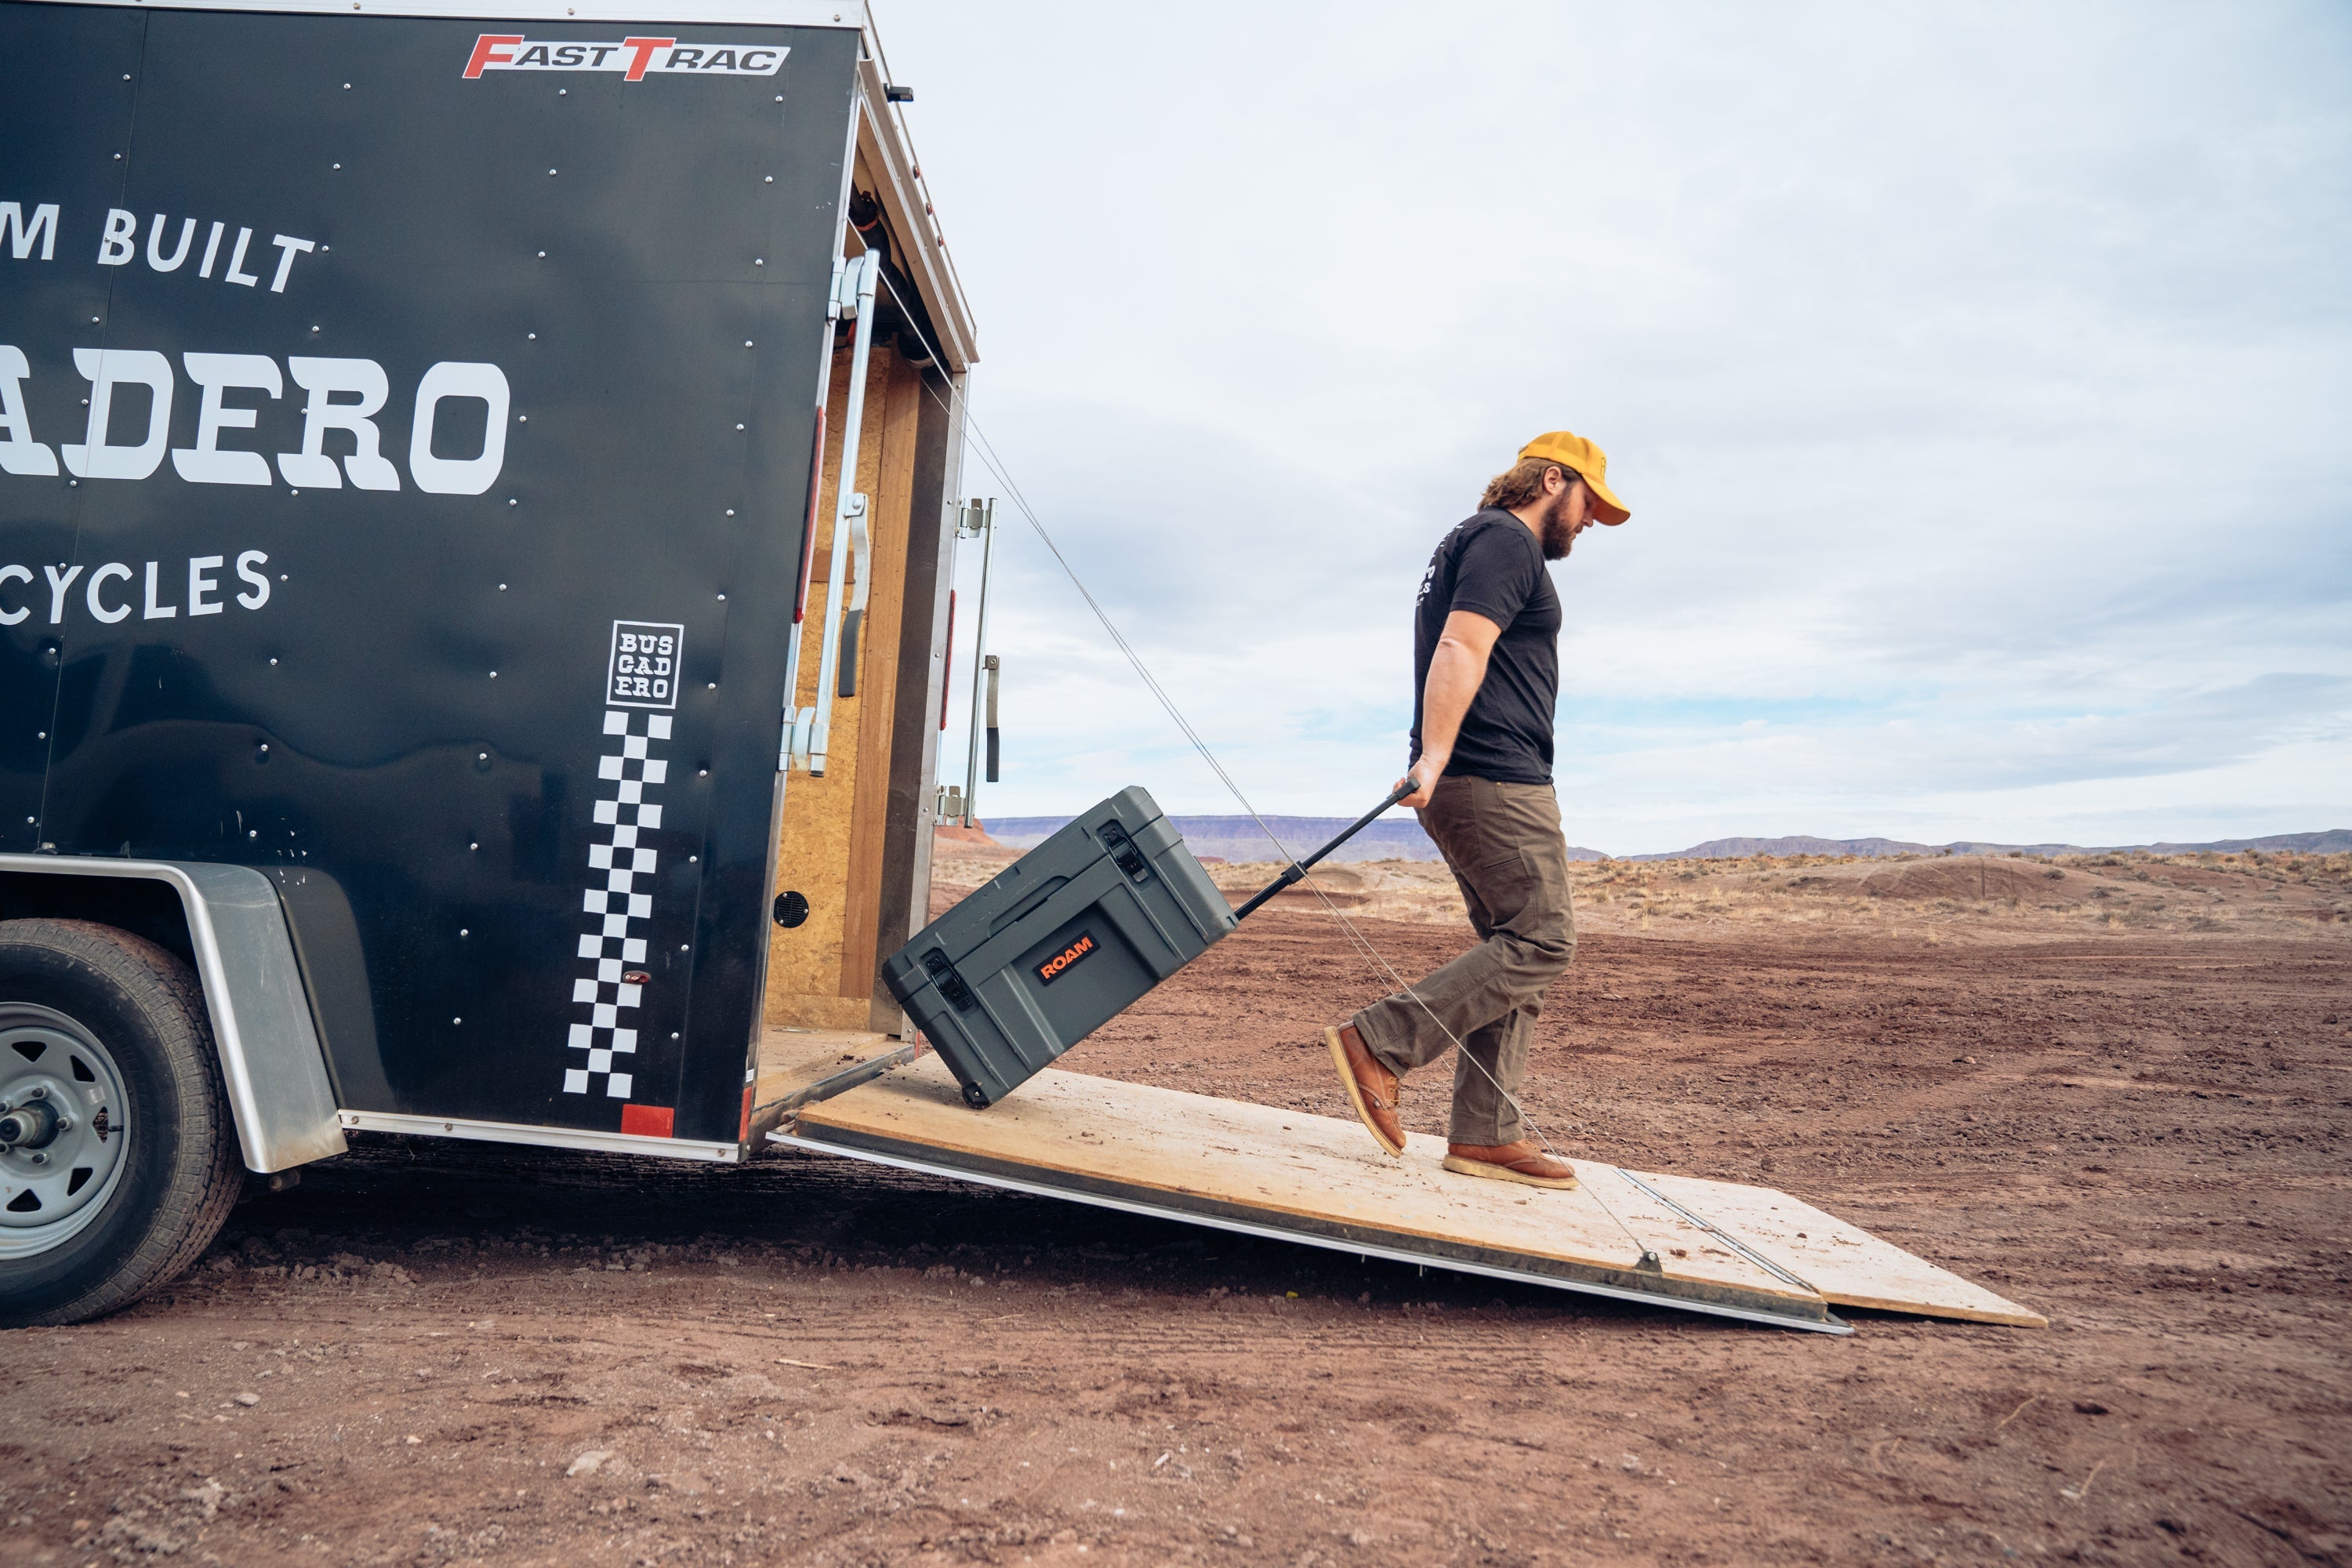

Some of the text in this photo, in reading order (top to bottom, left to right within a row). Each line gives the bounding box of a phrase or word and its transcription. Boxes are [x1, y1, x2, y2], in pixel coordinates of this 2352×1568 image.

[98, 209, 315, 292] BUILT
[0, 345, 510, 495] ADERO
[0, 550, 270, 625] CYCLES
[619, 633, 673, 655] BUS
[615, 676, 668, 699] ERO
[1041, 936, 1093, 979] ROAM
